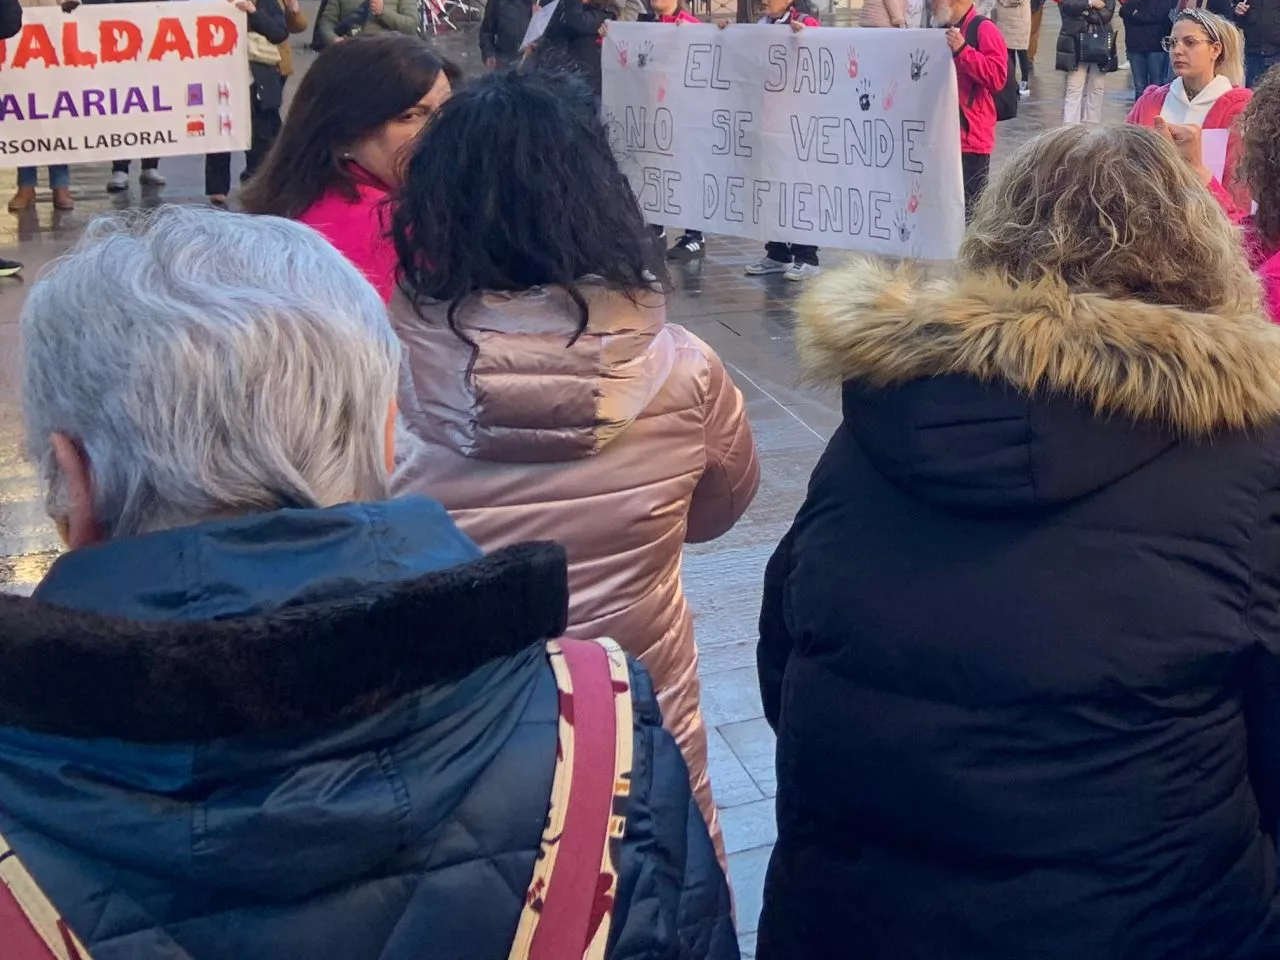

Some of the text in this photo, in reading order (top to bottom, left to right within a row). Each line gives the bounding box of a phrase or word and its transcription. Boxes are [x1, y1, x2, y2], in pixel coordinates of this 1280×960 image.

[0, 16, 239, 70] ALDAD
[683, 43, 836, 95] EL SAD
[84, 130, 178, 149] LABORAL
[625, 106, 926, 174] NO SE VENDE
[643, 166, 892, 240] SE DEFIENDE
